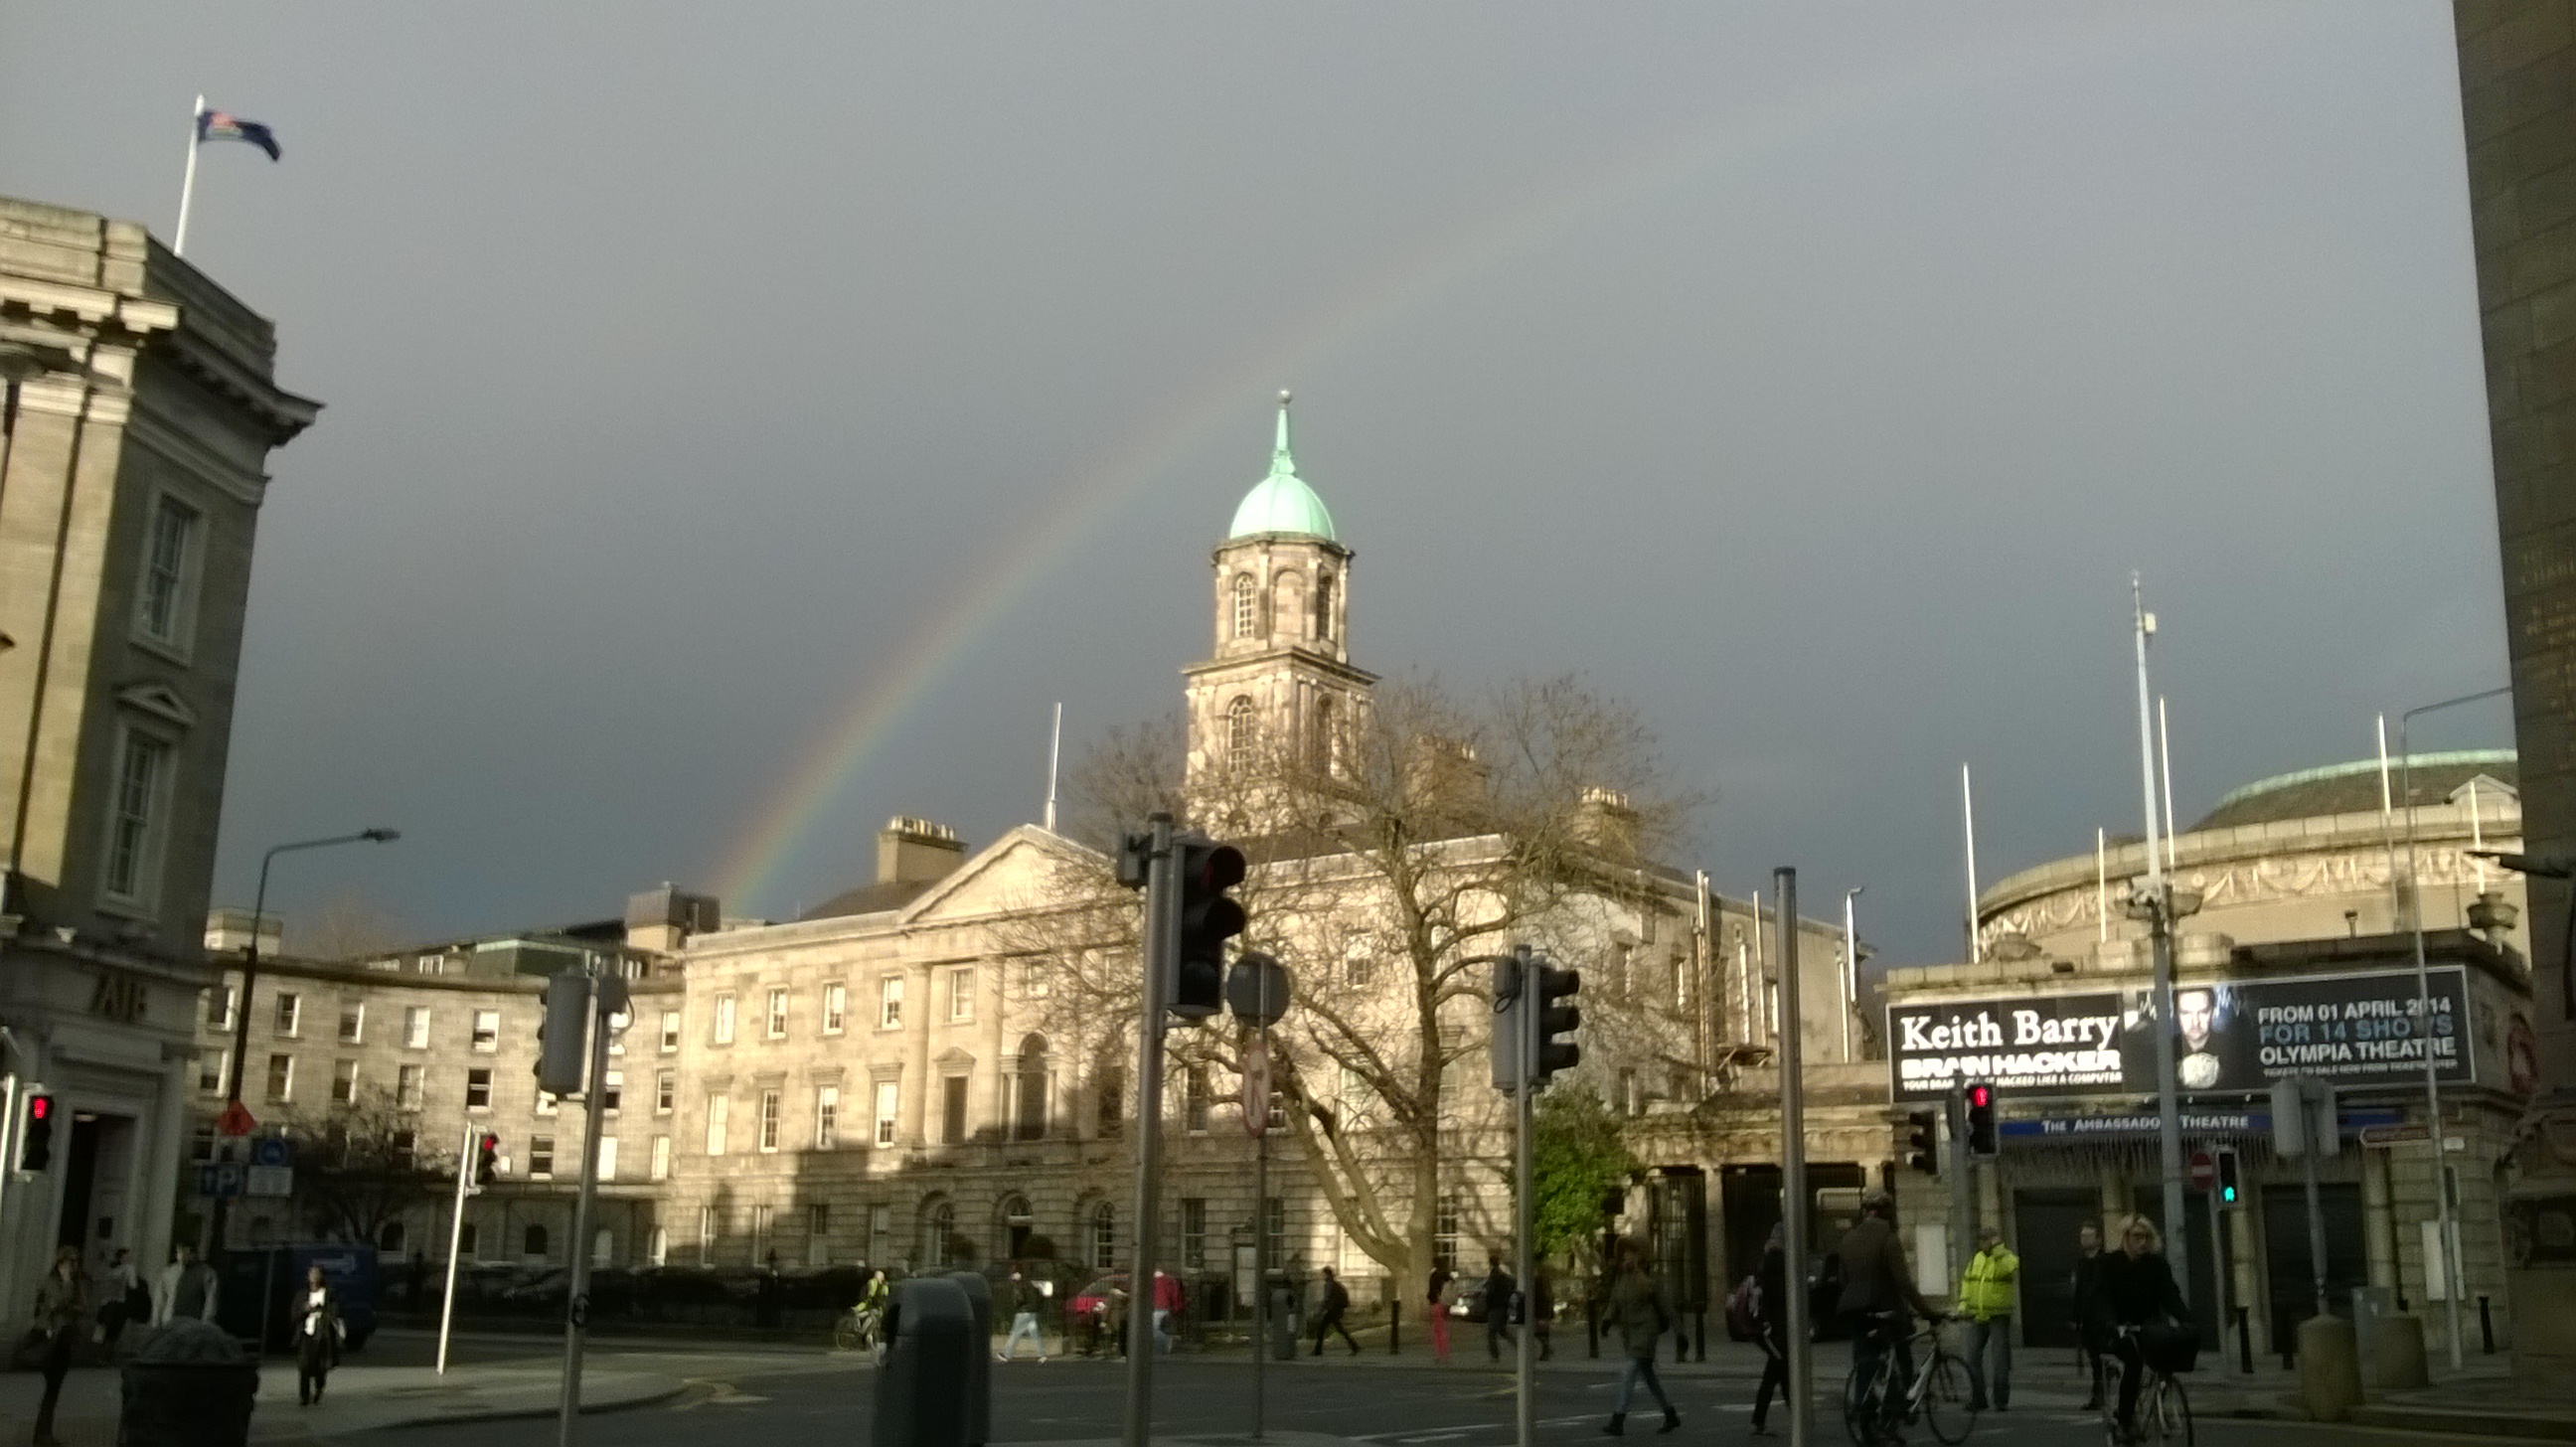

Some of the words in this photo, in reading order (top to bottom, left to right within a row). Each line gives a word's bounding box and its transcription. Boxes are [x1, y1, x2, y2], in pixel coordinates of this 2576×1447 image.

[2258, 1004, 2314, 1025] FROM
[2318, 1003, 2338, 1021] 01
[2343, 999, 2403, 1020] APRIL
[1900, 1010, 2004, 1050] Keith
[2012, 1010, 2120, 1050] Barry
[2259, 1023, 2311, 1044] FOR
[2321, 1021, 2347, 1041] 14
[2355, 1015, 2454, 1041] SHOS
[1992, 1048, 2122, 1075] HACKER
[2259, 1043, 2353, 1065] OLYMPIA
[2355, 1037, 2457, 1060] THEATRE
[2073, 1116, 2163, 1132] AMBASSADO
[2180, 1114, 2250, 1130] THEATRE
